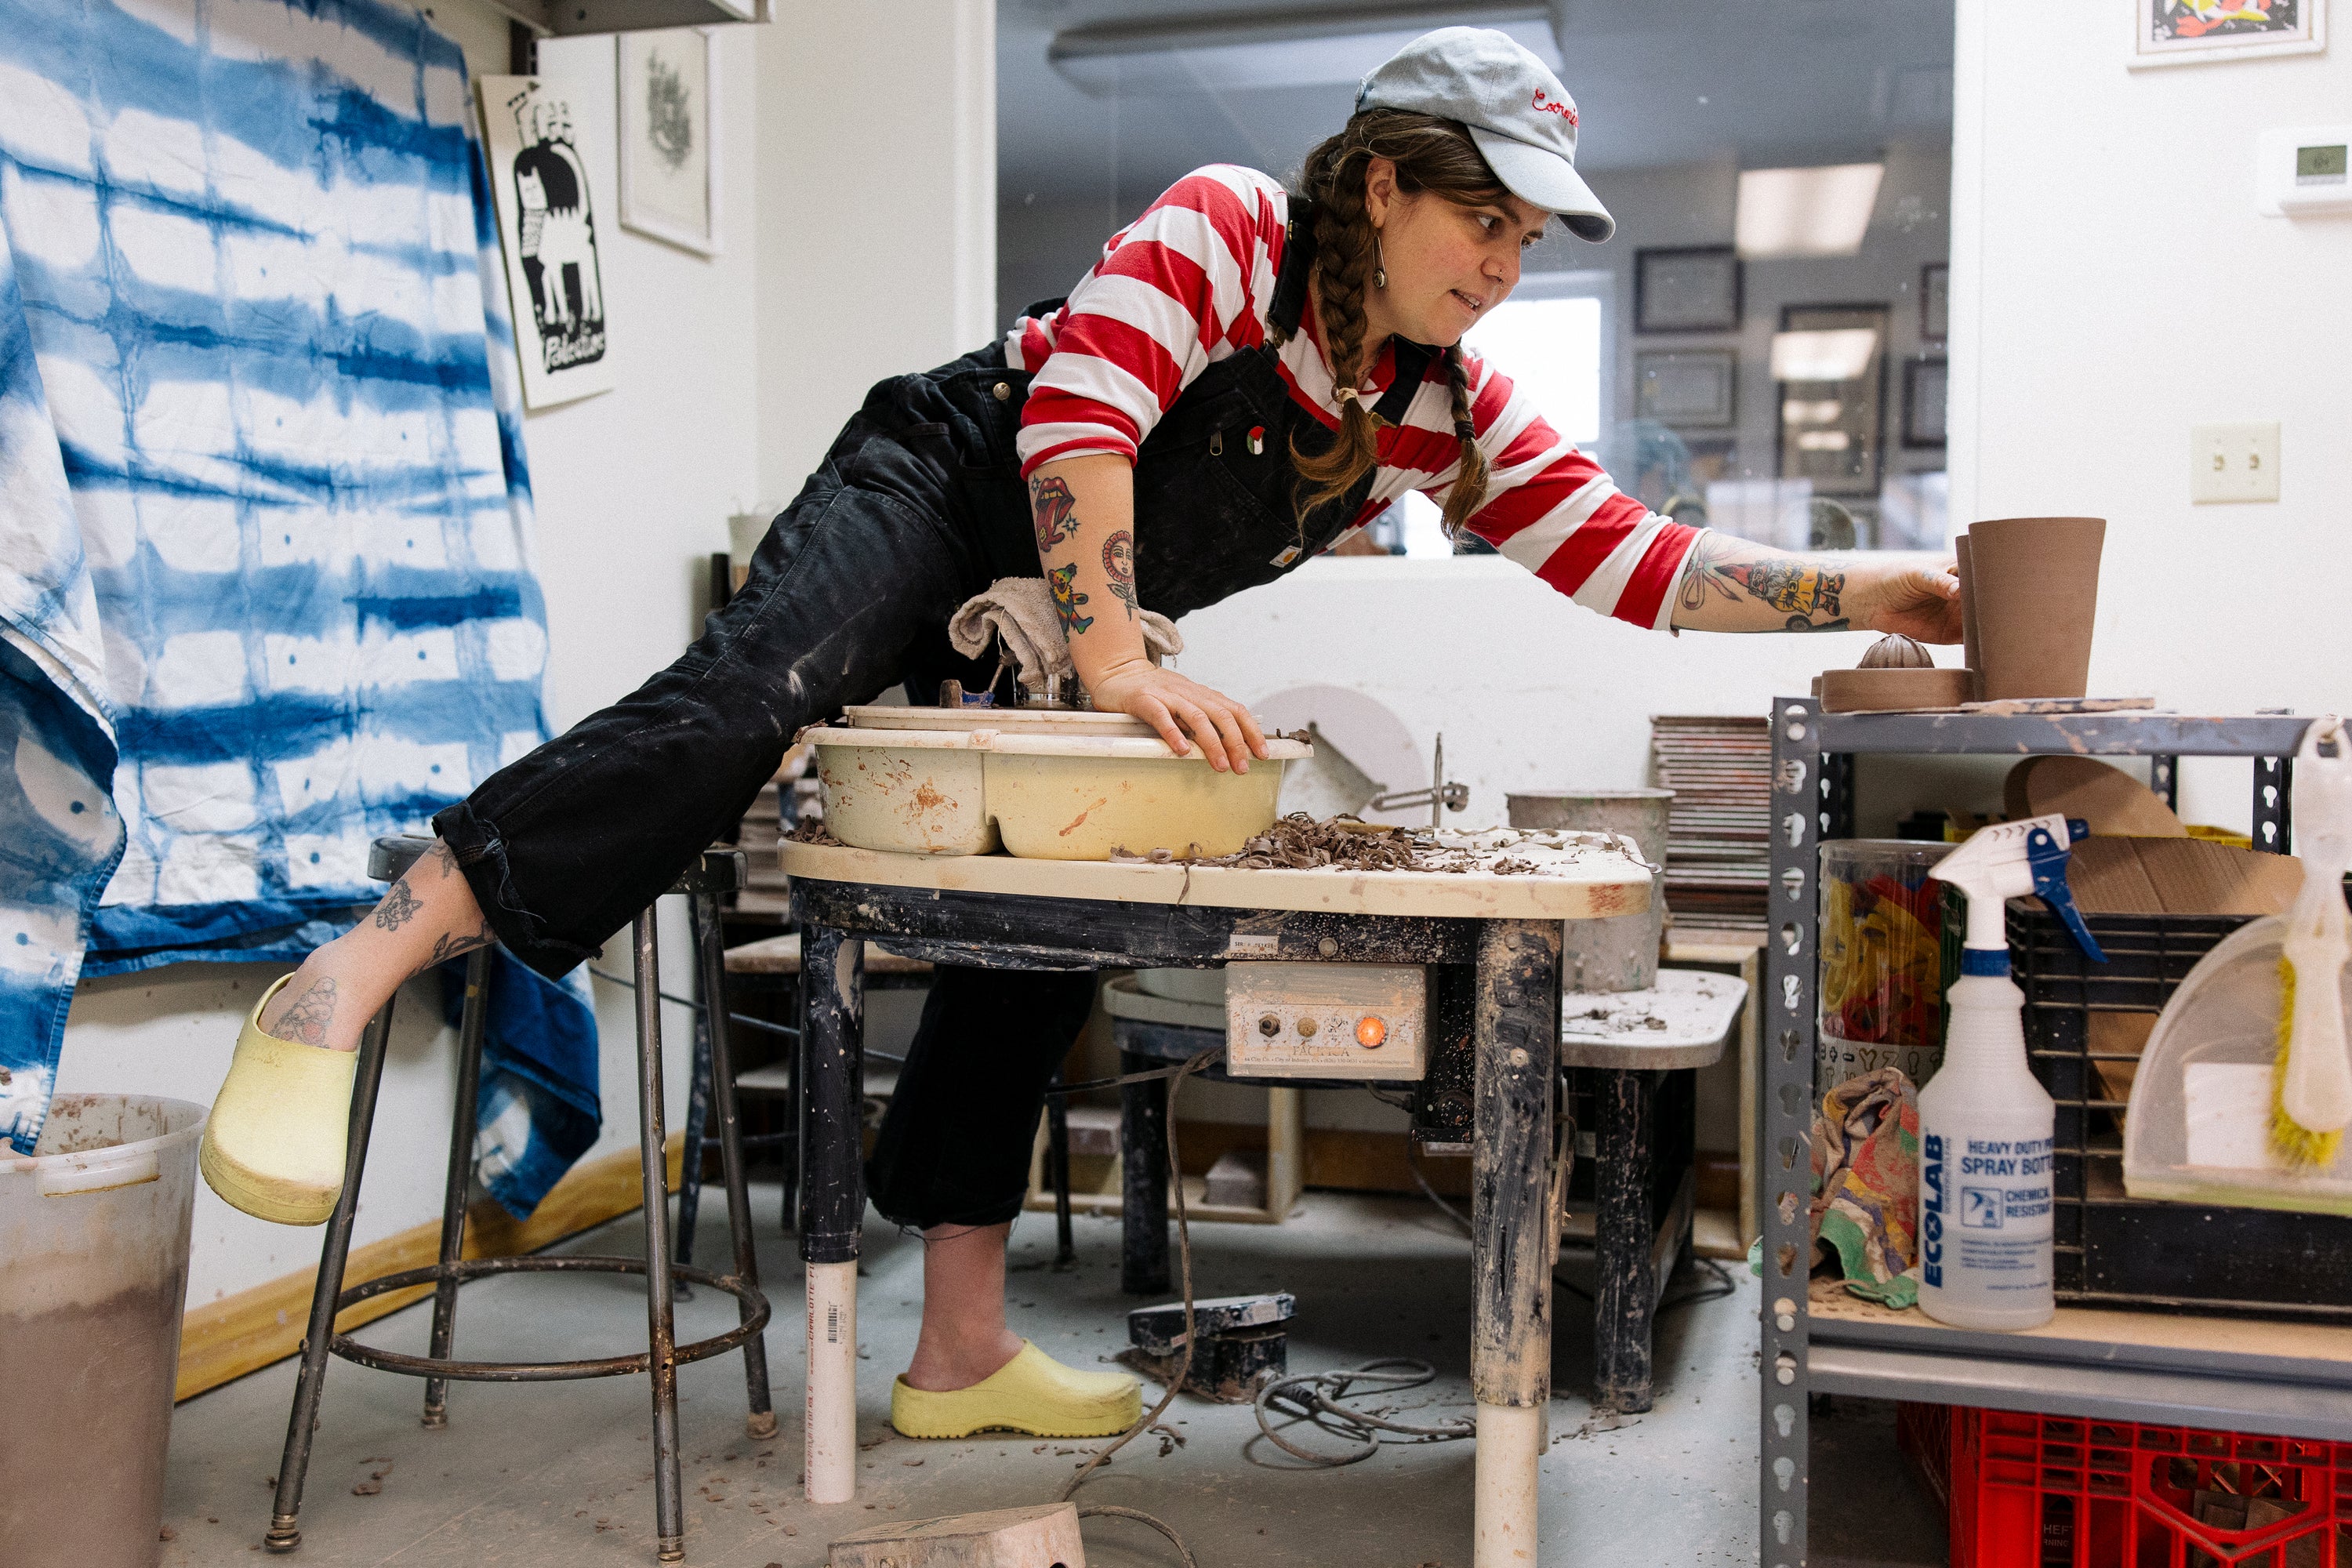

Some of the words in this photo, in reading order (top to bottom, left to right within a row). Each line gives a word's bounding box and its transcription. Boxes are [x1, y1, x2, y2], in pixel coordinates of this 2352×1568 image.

[1968, 1141, 2012, 1155] HEAVY
[2015, 1140, 2042, 1155] DUTY
[1962, 1156, 2017, 1175] SPRAY
[2022, 1154, 2054, 1175] BOTTL
[1924, 1134, 1943, 1288] ECOLAB
